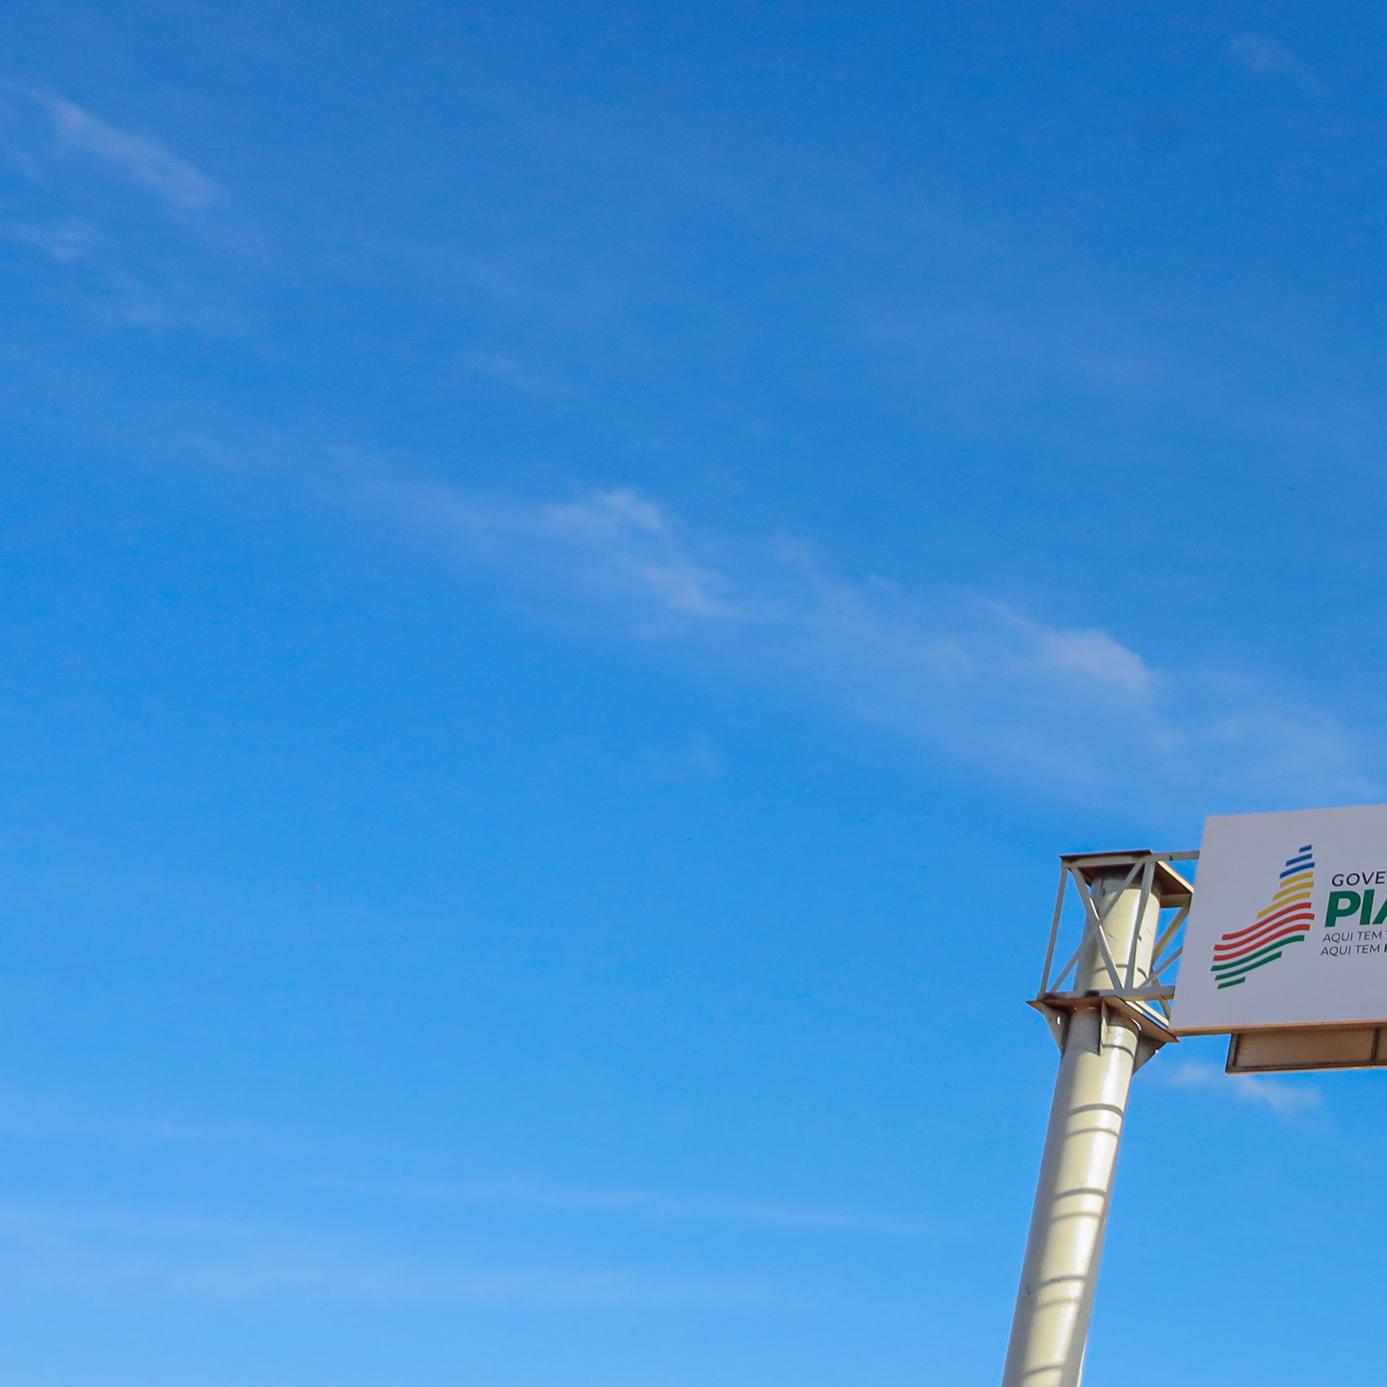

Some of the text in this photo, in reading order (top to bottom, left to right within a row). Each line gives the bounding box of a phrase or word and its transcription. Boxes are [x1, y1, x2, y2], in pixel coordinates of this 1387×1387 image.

[1322, 932, 1353, 943] AQUI
[1358, 930, 1382, 941] TEM
[1320, 946, 1351, 957] AQUI
[1355, 944, 1380, 955] TEM
